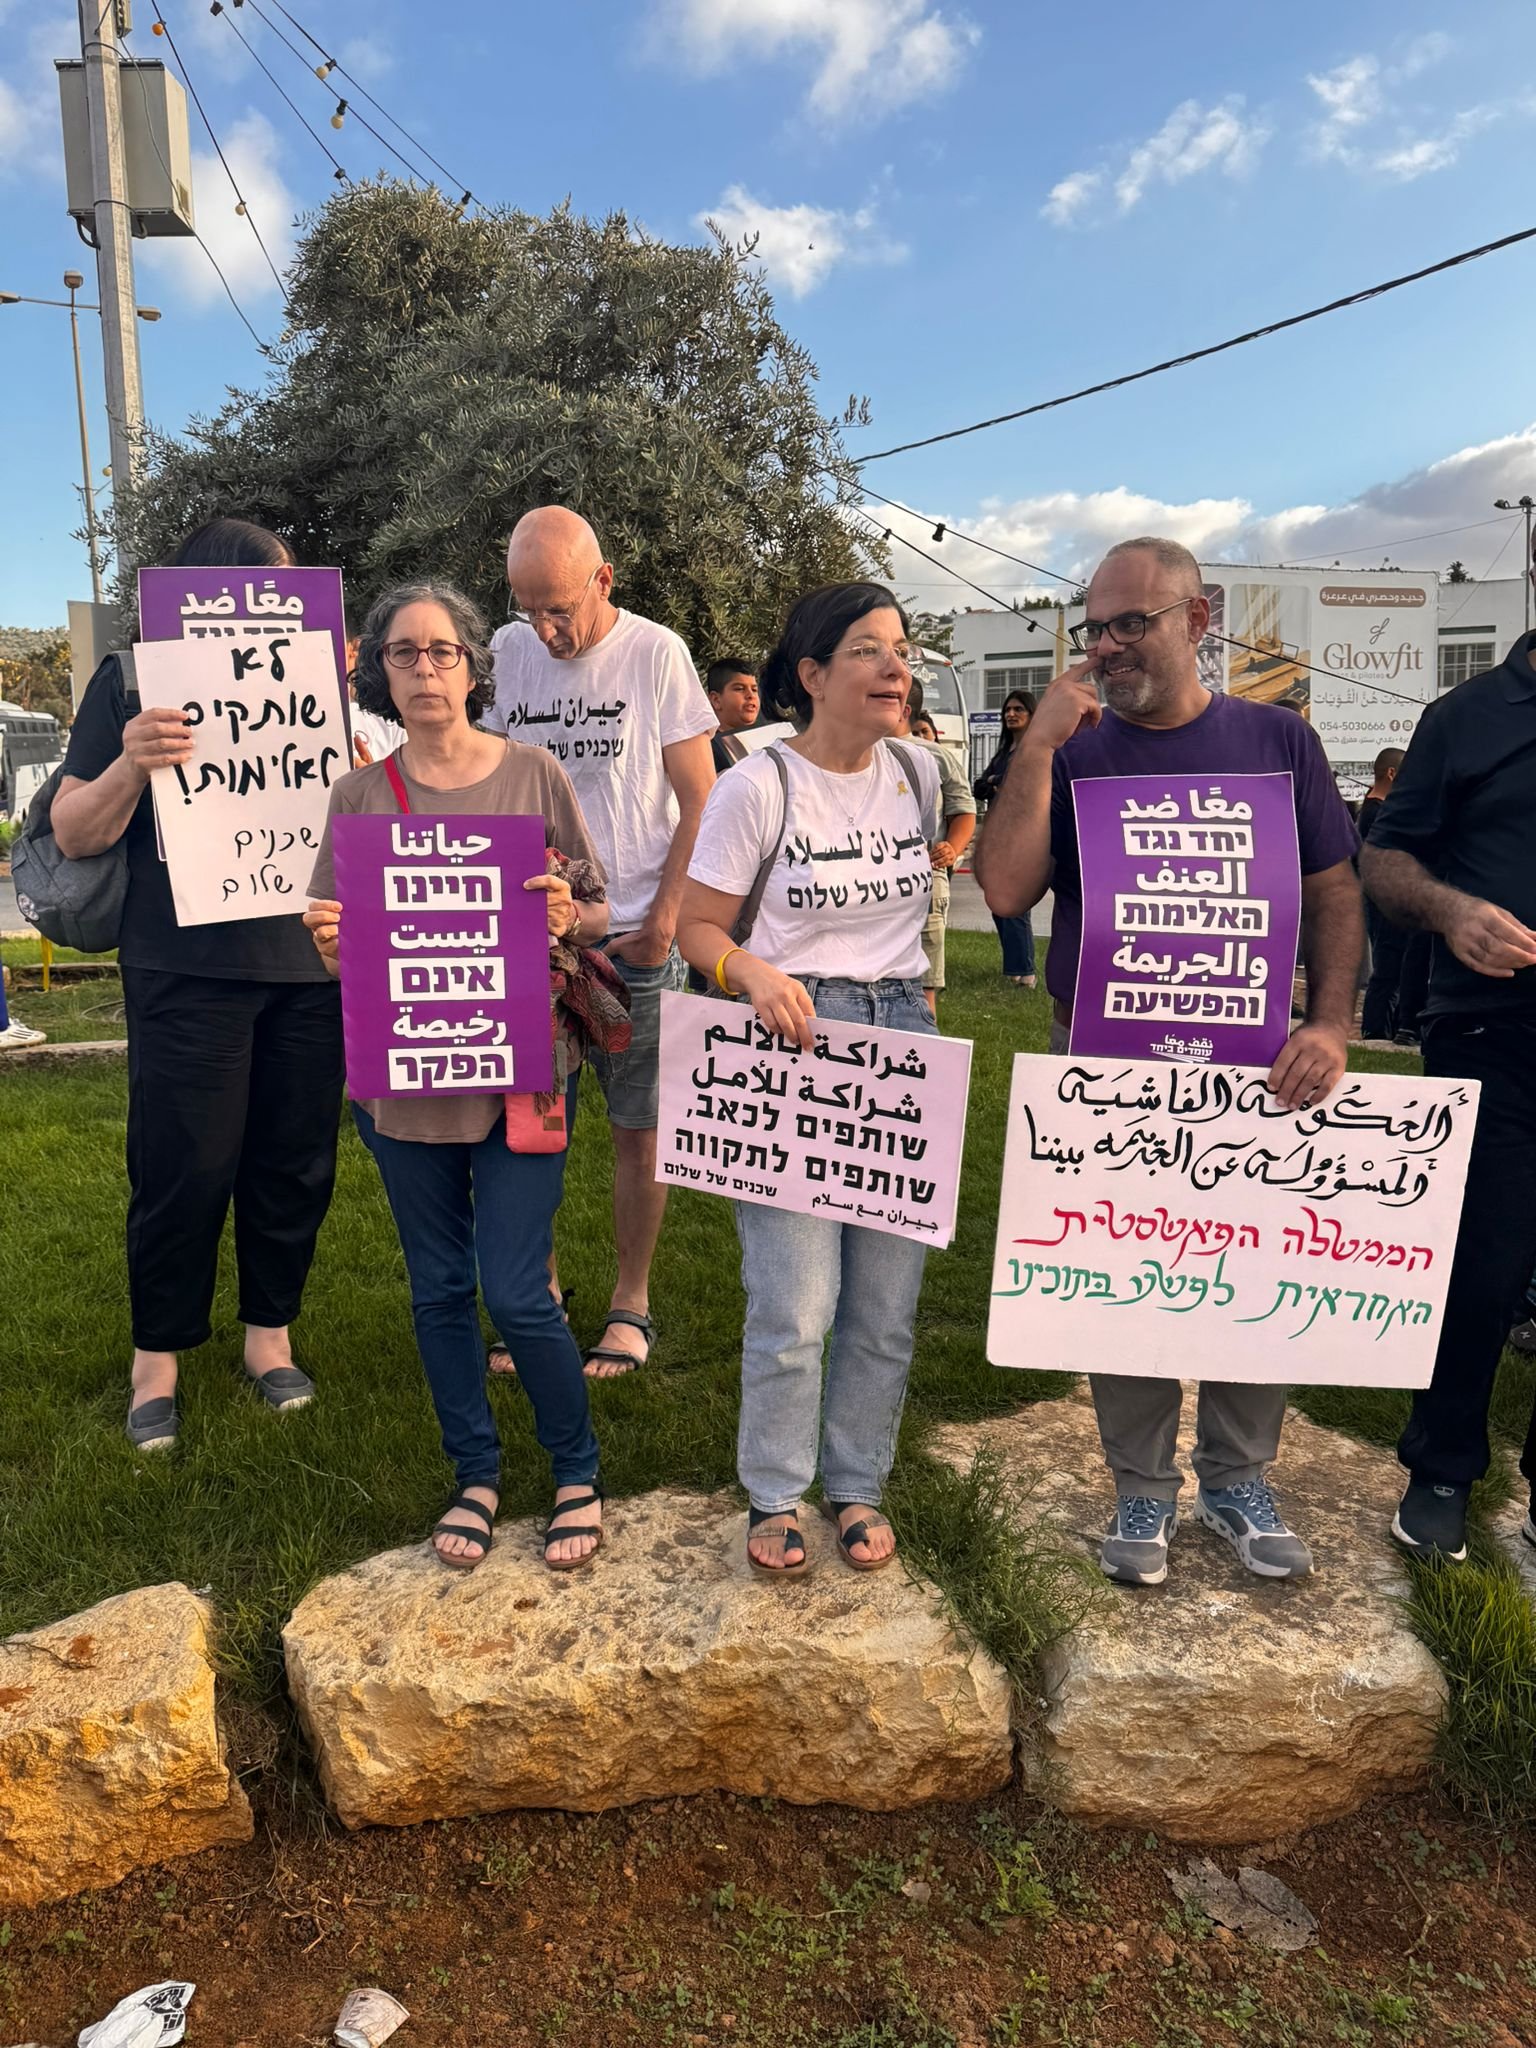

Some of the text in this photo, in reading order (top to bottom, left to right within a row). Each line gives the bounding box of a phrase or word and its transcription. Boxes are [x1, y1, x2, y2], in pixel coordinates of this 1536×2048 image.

[180, 580, 304, 616] معًا ضد
[1347, 592, 1366, 605] في
[1400, 593, 1425, 603] جديد
[230, 638, 291, 682] לא
[1322, 642, 1424, 679] Glowfit
[181, 691, 327, 744] שותקים
[506, 696, 627, 731] جيران للسلام
[1319, 720, 1386, 731] 054-5030666
[573, 737, 624, 759] שכנים
[172, 742, 340, 806] לאלימות!
[1119, 786, 1253, 820] معًا ضد
[234, 826, 319, 860] שכנים
[391, 822, 492, 864] حياتنا
[784, 829, 863, 869] للسلام
[1130, 829, 1248, 853] יחד נגד
[221, 863, 293, 902] שלום
[392, 875, 493, 903] חיינו
[786, 880, 849, 910] שלום
[854, 877, 889, 905] של
[1136, 860, 1248, 895] العنف
[1122, 898, 1263, 931] האלימות
[390, 914, 499, 954] ليست
[400, 965, 497, 994] אינם
[1112, 935, 1269, 988] والجريمة
[1112, 989, 1261, 1020] והפשיעה
[391, 1006, 508, 1046] رخيصة
[1149, 1043, 1213, 1057] עומדים ביחד
[395, 1051, 507, 1090] הפקר
[691, 1056, 788, 1098] للأمل
[686, 1093, 928, 1162] שותפים לכאב,
[1024, 1103, 1085, 1175] بيننا
[663, 1161, 778, 1198] שכנים של שלום
[675, 1127, 937, 1205] שותפים לתקווה
[811, 1192, 940, 1234] جيران مع سلام
[1011, 1199, 1434, 1273] הממשלה הפאשסטית
[1101, 1250, 1236, 1313] לפשע
[1231, 1279, 1434, 1342] האחראית
